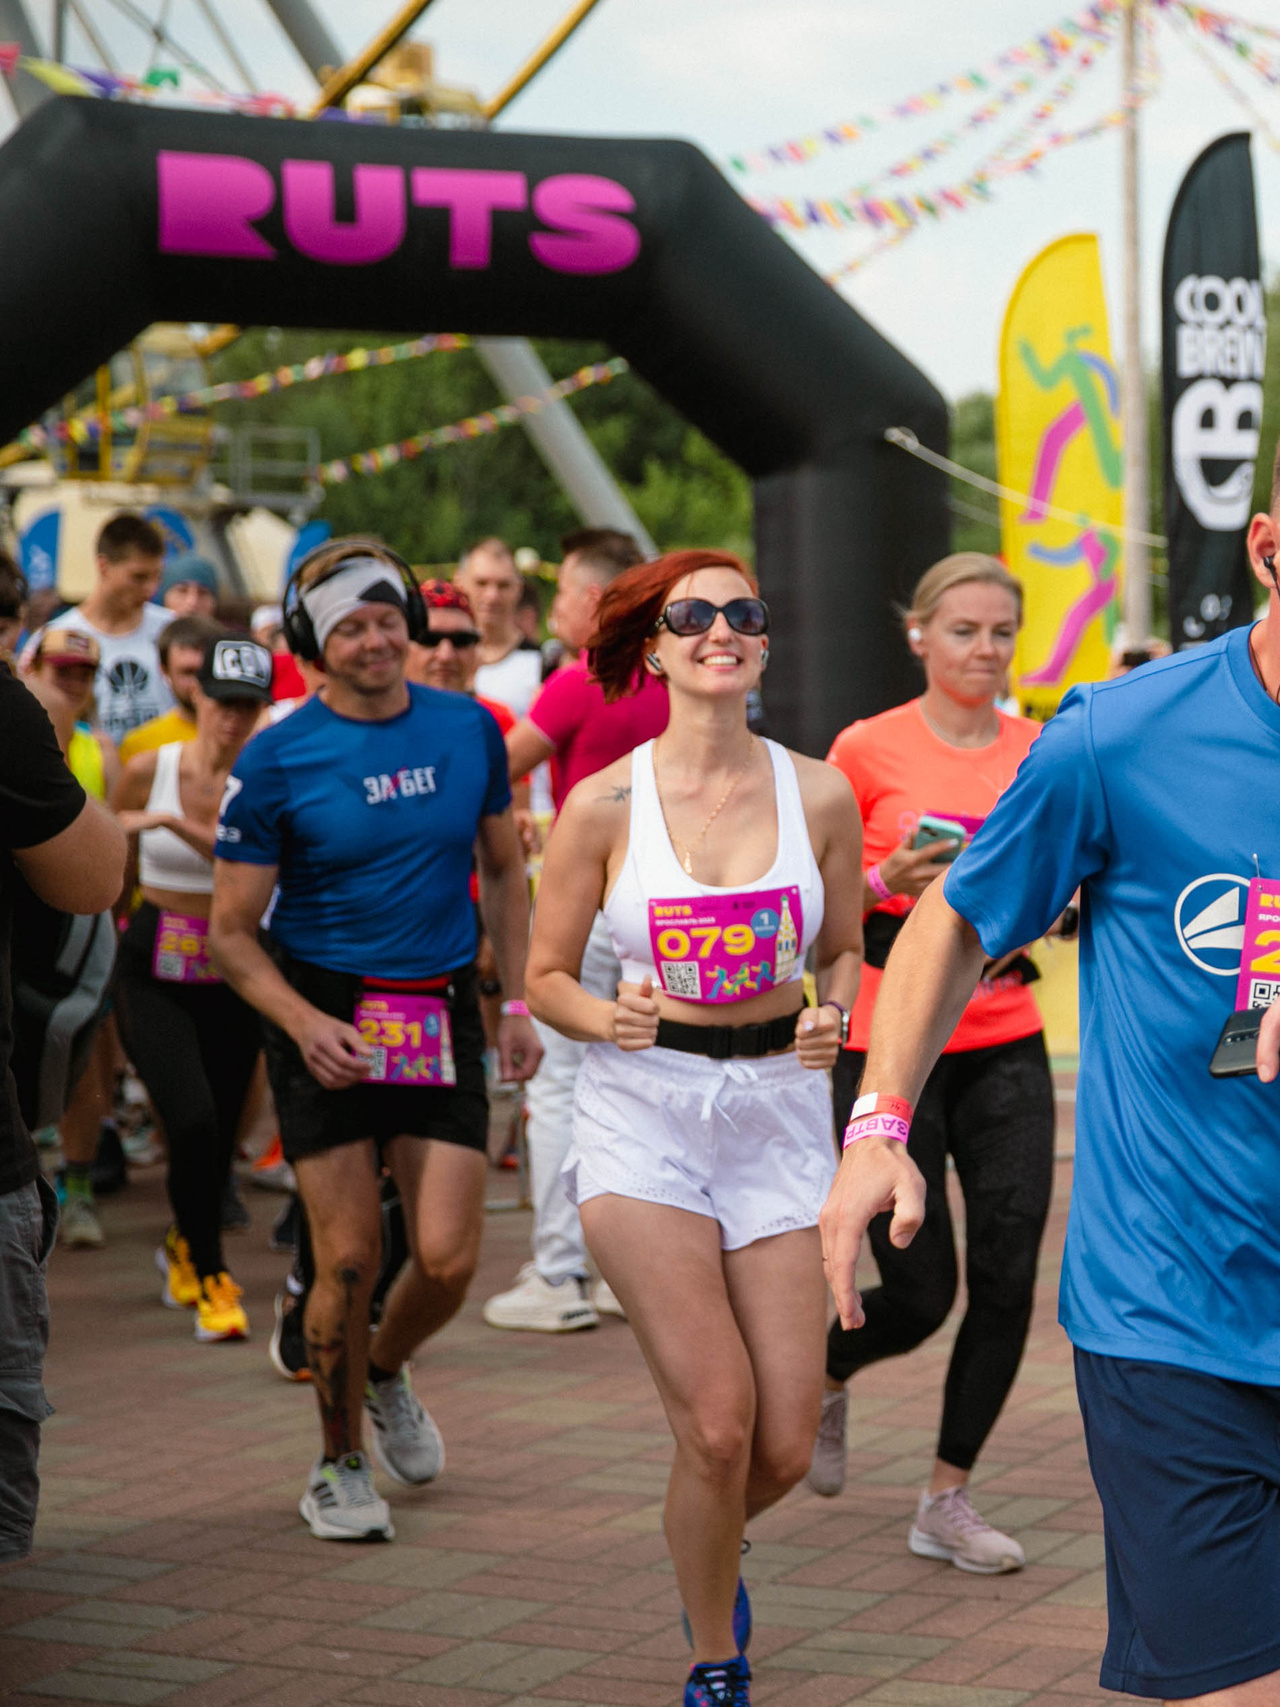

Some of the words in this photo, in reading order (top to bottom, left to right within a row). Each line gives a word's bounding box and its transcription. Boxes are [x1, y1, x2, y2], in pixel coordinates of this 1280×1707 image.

[156, 149, 641, 275] RUTS
[363, 766, 436, 805] ЗАБЕГ
[657, 924, 756, 960] 079
[359, 1018, 422, 1049] 231
